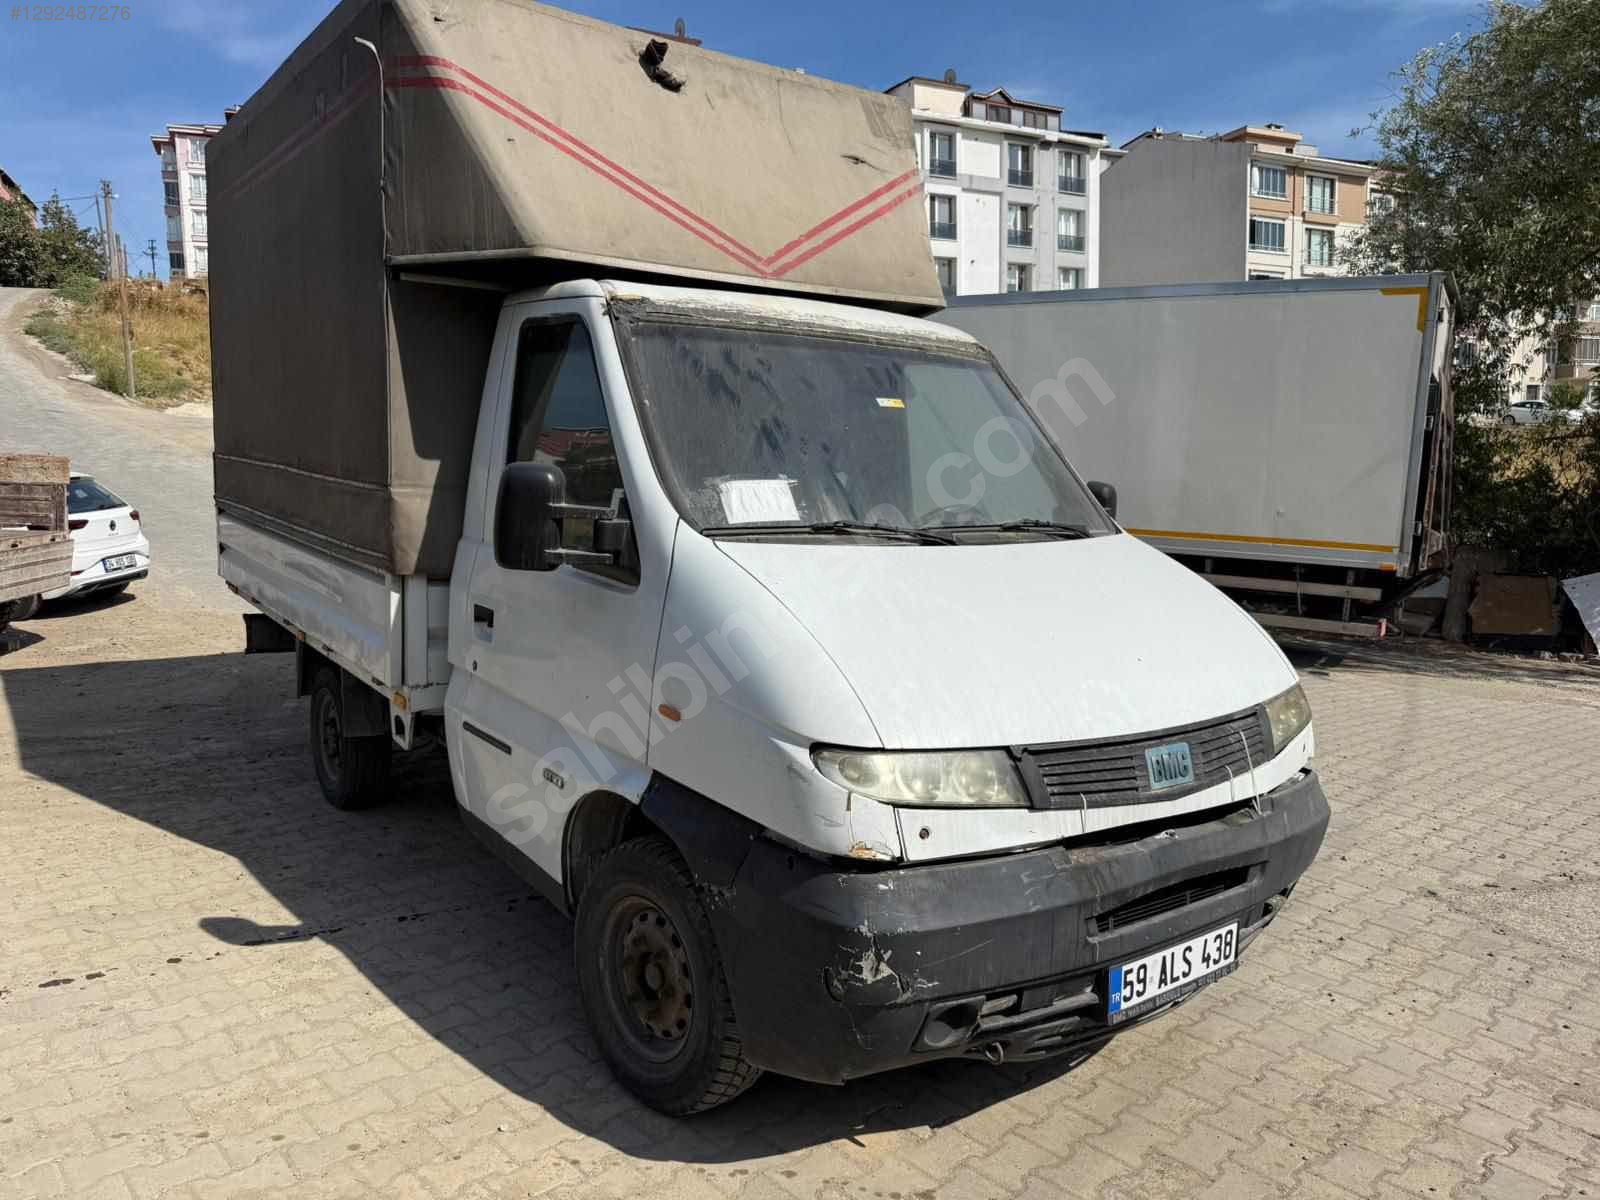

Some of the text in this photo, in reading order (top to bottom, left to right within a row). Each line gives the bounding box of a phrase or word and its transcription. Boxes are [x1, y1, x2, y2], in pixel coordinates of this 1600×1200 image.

[1151, 750, 1190, 784] BMC
[1122, 963, 1148, 1003] 59
[1157, 945, 1193, 990] ALS
[1201, 928, 1234, 970] 438
[1111, 992, 1121, 1005] TR
